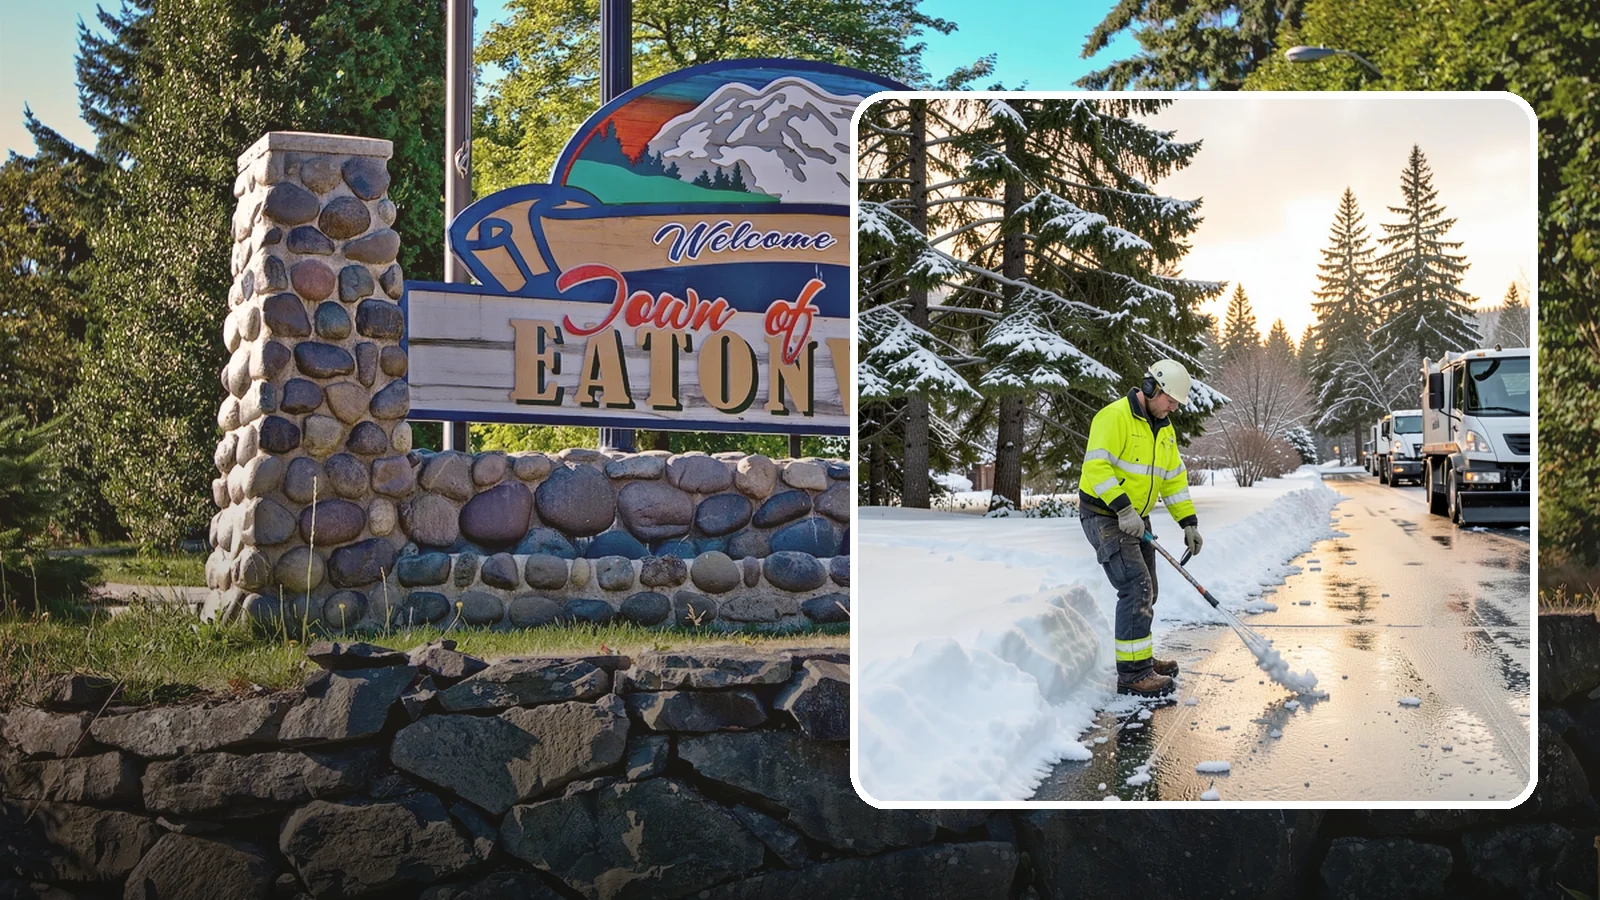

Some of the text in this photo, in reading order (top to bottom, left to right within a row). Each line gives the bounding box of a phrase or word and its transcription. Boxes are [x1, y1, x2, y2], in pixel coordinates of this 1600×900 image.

[653, 220, 838, 263] Welcome
[556, 263, 826, 365] Town of
